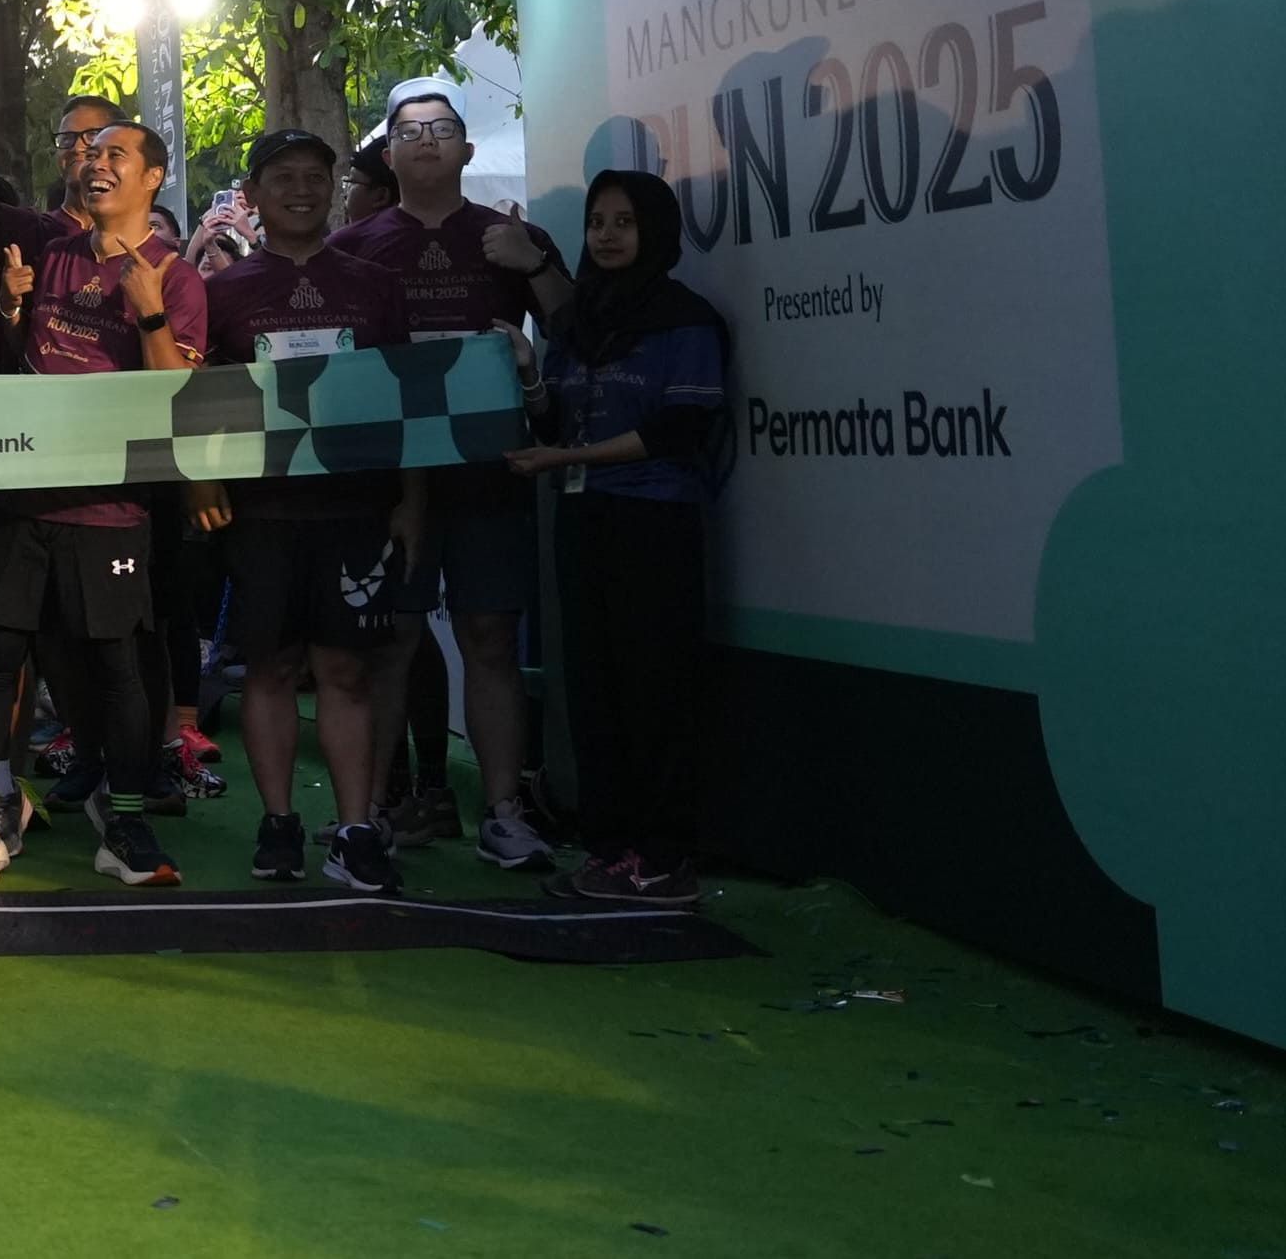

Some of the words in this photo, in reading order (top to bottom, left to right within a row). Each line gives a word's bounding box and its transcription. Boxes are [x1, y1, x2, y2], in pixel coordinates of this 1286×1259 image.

[802, 0, 1062, 233] 2025
[764, 276, 854, 323] Presented
[859, 273, 884, 323] by
[47, 316, 71, 334] RUN
[72, 322, 101, 342] 2025
[748, 397, 895, 458] Permata
[903, 387, 1011, 458] Bank
